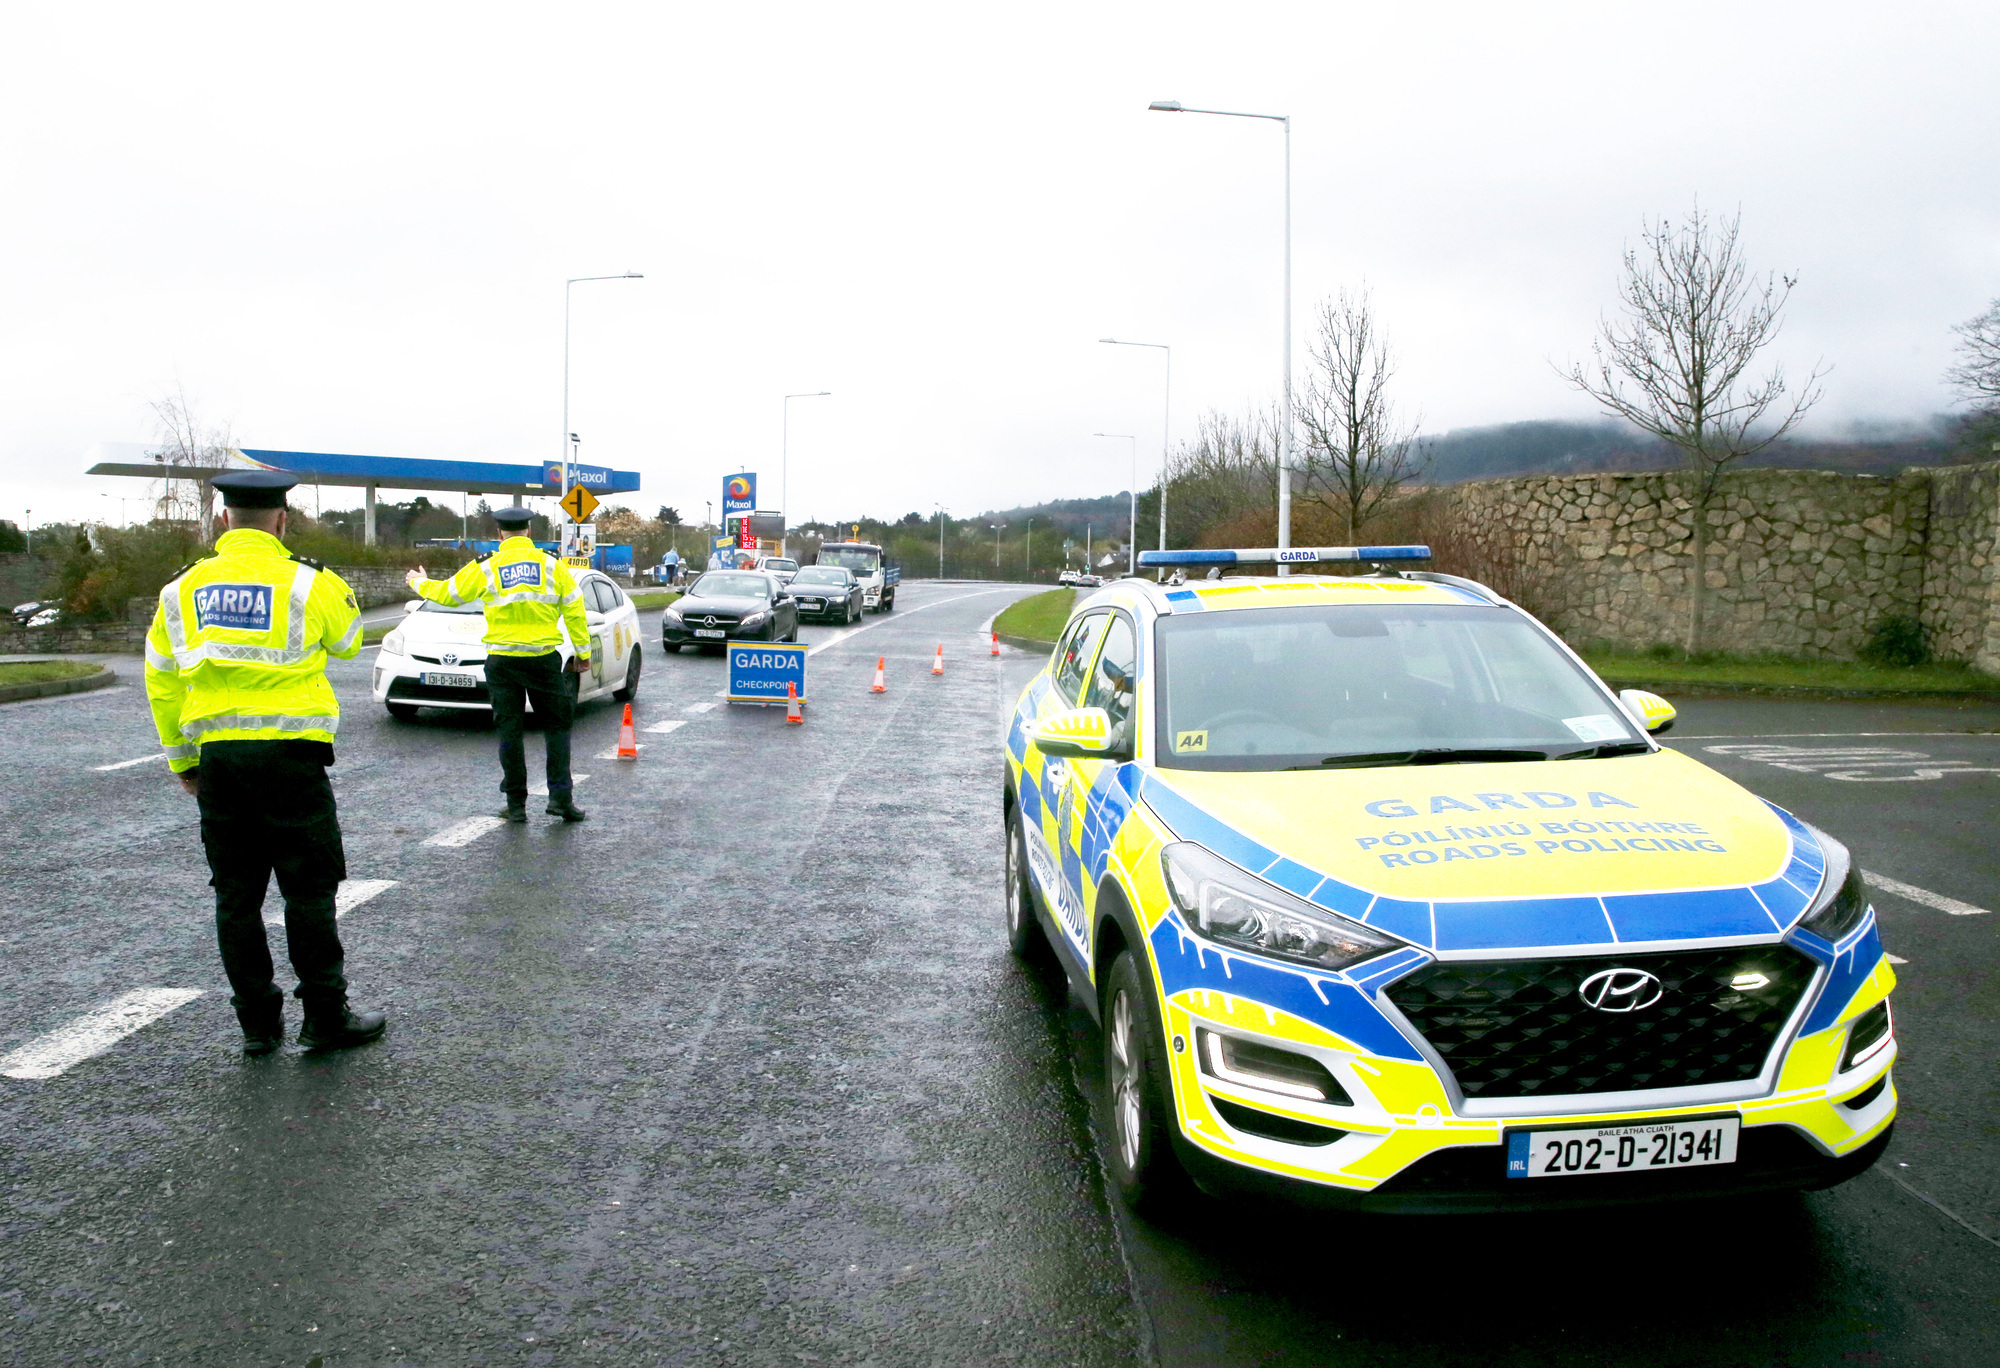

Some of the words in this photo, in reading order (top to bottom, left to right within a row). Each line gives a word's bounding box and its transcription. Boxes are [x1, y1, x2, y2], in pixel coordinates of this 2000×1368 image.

[568, 469, 607, 484] Maxol
[726, 500, 751, 509] Maxol
[568, 557, 588, 567] 41019
[1280, 551, 1317, 561] GARDA
[501, 564, 539, 581] GARDA
[197, 589, 267, 615] GARDA
[222, 615, 266, 625] POLICING
[735, 653, 800, 670] GARDA
[428, 675, 473, 687] 131-D-34859
[1180, 734, 1203, 747] AA
[1364, 791, 1640, 818] GARDA
[1355, 822, 1532, 850] PÓILÍNIÚ
[1539, 819, 1710, 835] BÓITHRE
[1379, 842, 1528, 868] ROADS
[1534, 838, 1728, 854] POLICING
[1598, 1128, 1621, 1137] BAILE
[1646, 1125, 1675, 1133] CLIATH
[1544, 1128, 1723, 1173] 202-D-21341
[1510, 1160, 1526, 1171] IRL
